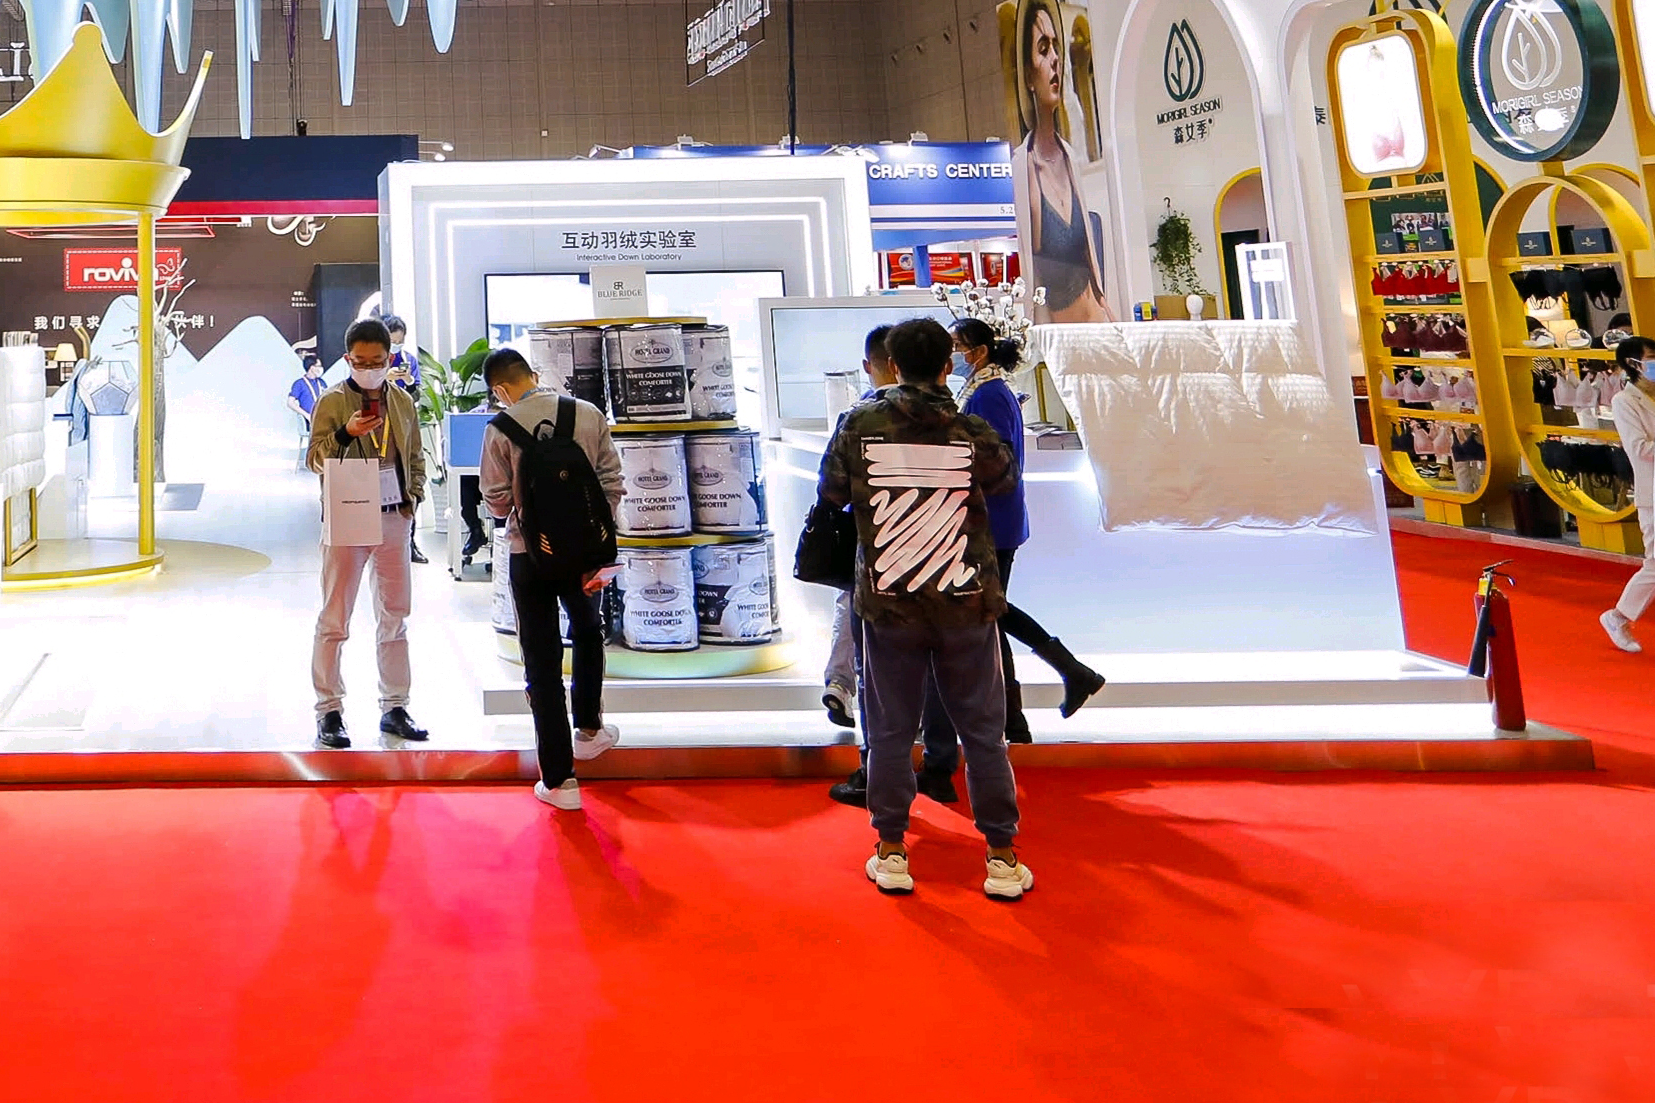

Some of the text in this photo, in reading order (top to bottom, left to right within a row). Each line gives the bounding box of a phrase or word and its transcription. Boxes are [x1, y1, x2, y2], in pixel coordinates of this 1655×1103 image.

[1190, 98, 1221, 116] SEASON
[1492, 94, 1541, 115] MORIGIRL
[868, 163, 1013, 180] CRAFTS CENTER
[561, 230, 696, 250] 互动羽绒实验室
[576, 253, 682, 261] Interactive Down Laboratory
[597, 289, 643, 298] BLUE RIDGE
